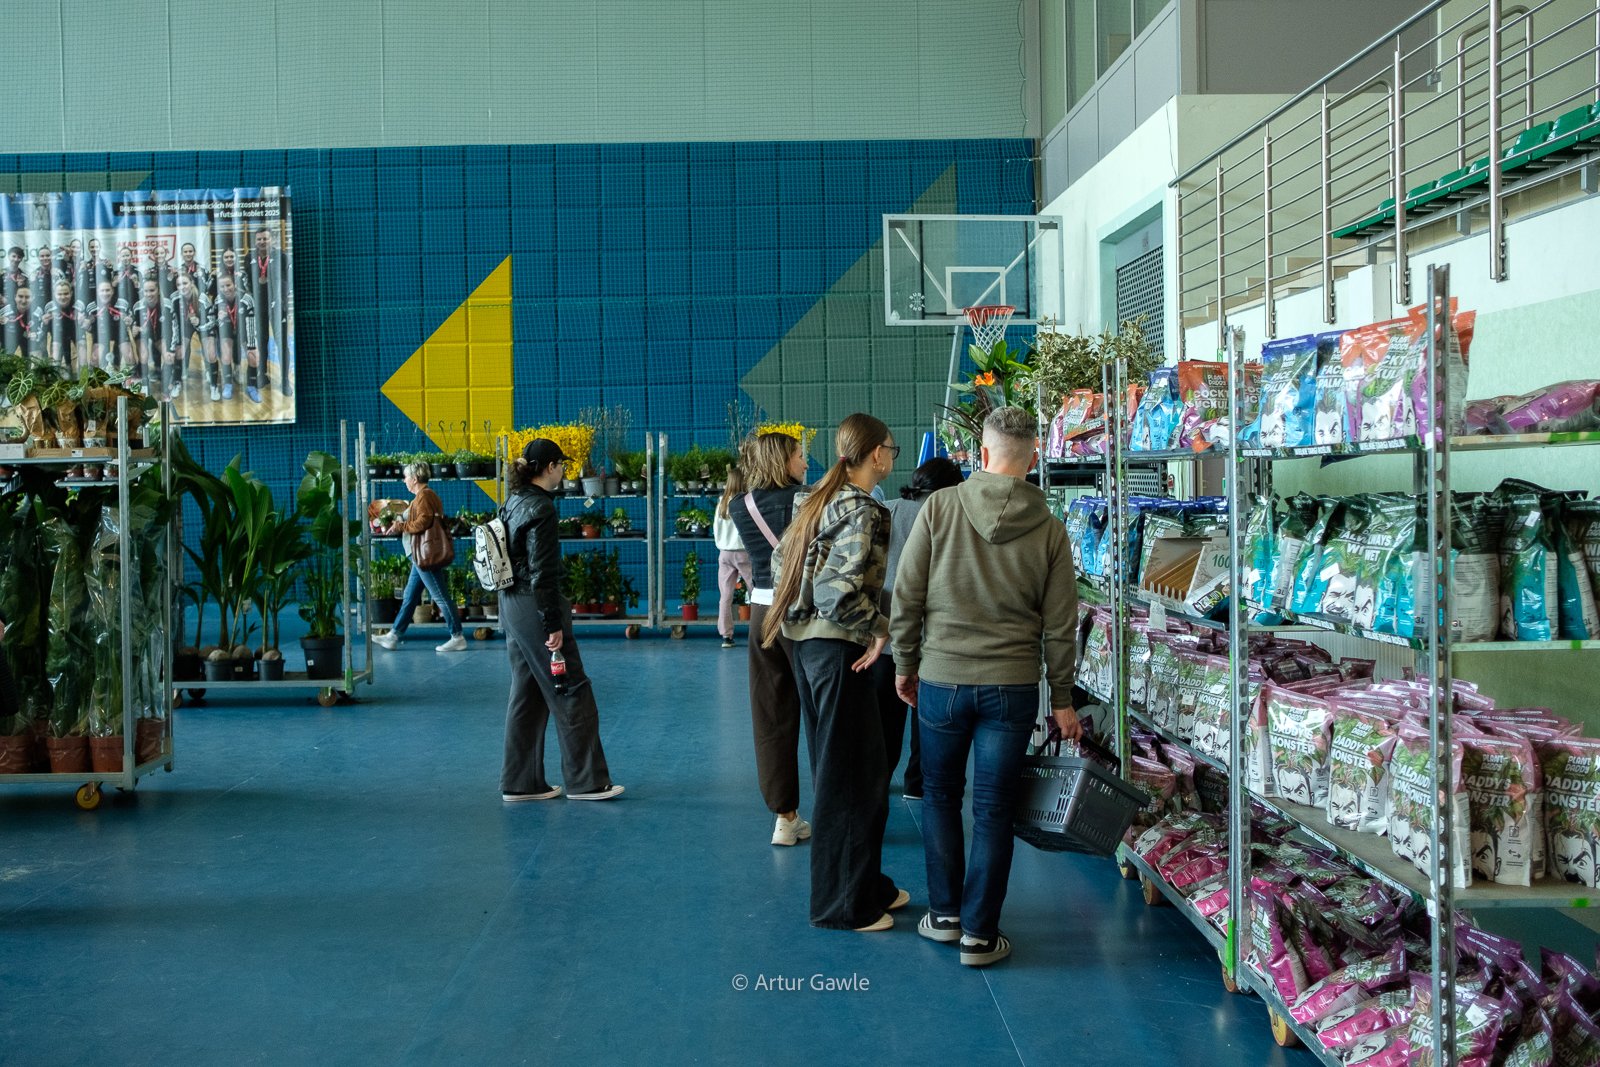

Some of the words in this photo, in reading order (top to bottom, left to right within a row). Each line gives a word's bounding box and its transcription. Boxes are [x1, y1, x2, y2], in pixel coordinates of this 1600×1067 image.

[146, 203, 180, 212] medalistki
[180, 202, 225, 210] Akademickich
[225, 201, 260, 209] Mistrzostw
[260, 200, 280, 208] Polski
[242, 210, 264, 218] kobiet
[264, 209, 280, 217] 2025
[1270, 370, 1292, 381] FACE
[1364, 550, 1381, 562] WET
[1276, 588, 1286, 596] 3L
[1415, 616, 1425, 624] 3L
[1452, 620, 1463, 628] 3L
[1333, 735, 1371, 755] DADDY'S
[1482, 753, 1504, 763] PLANT
[1568, 755, 1592, 766] PLANT
[1480, 762, 1503, 772] DADDY
[1565, 764, 1590, 774] DADDY
